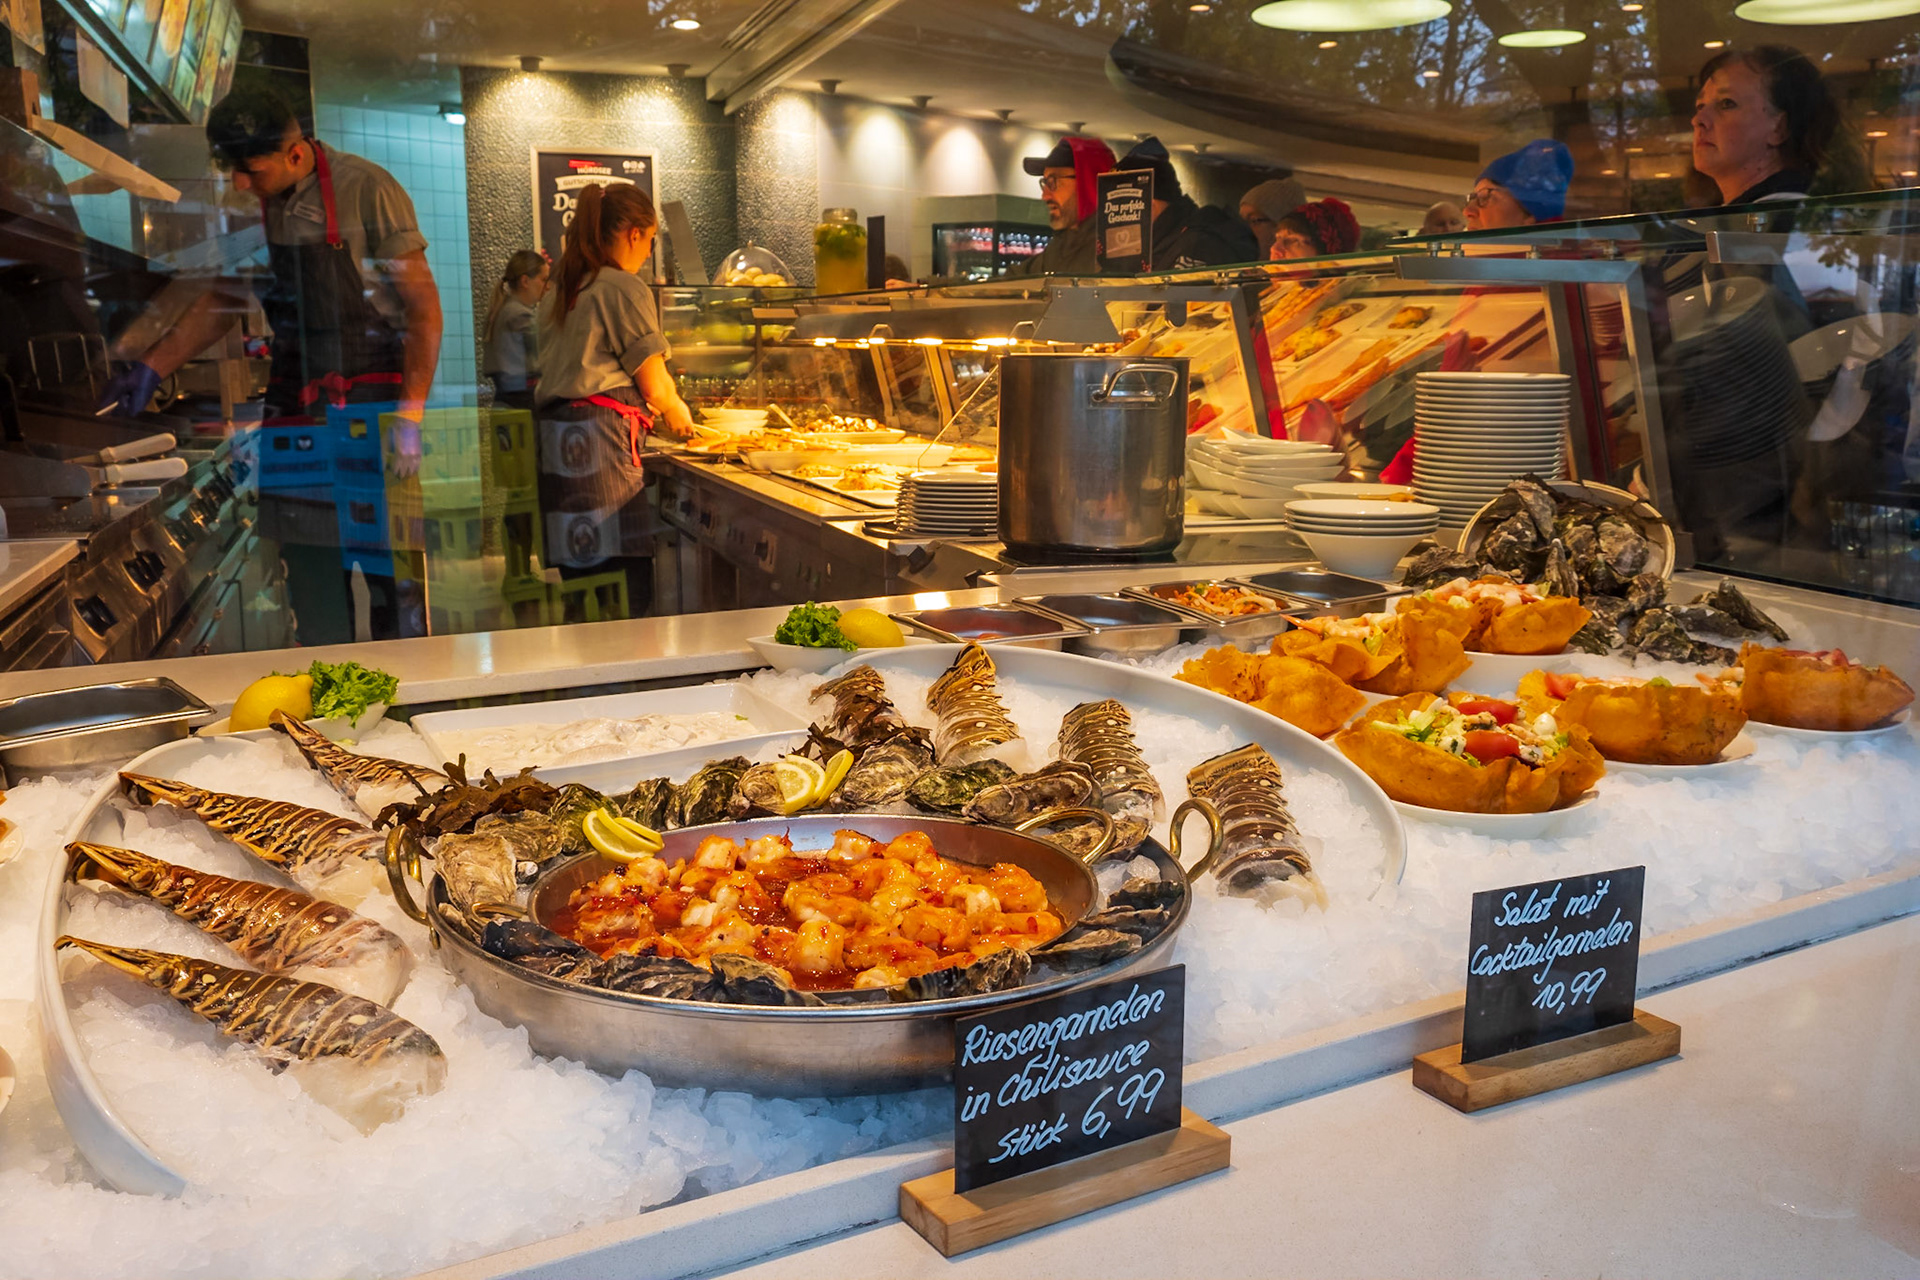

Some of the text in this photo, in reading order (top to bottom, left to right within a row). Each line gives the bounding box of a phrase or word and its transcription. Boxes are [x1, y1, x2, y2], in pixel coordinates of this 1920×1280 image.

[553, 193, 578, 211] Da
[1104, 202, 1119, 213] Das
[1494, 879, 1611, 927] Salat mit
[1470, 908, 1633, 985] Cocktailgarnelen
[1532, 967, 1607, 1015] 10,99
[961, 984, 1165, 1070] Riesengarnelen
[961, 1040, 1150, 1122] in Chilisauce
[1081, 1068, 1165, 1138] 6,99
